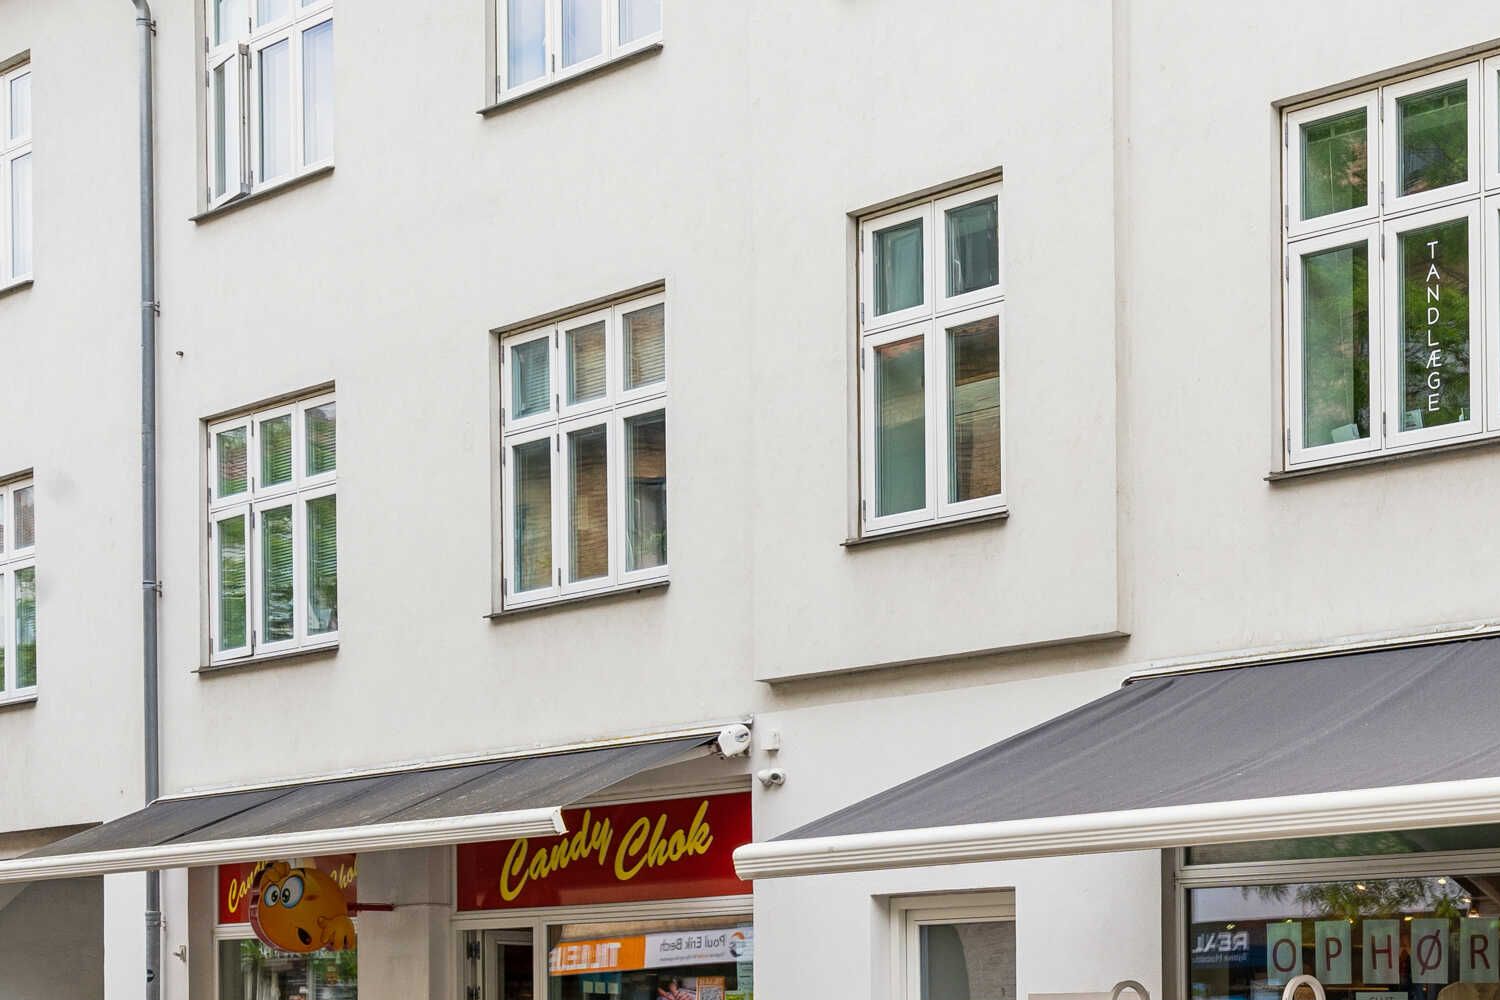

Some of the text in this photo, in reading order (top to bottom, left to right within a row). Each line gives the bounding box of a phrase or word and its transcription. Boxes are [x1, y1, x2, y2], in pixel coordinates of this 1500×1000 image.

[1426, 240, 1442, 412] TANDLÆGE
[500, 800, 714, 901] Candy Chok
[1272, 929, 1491, 976] OPHØR
